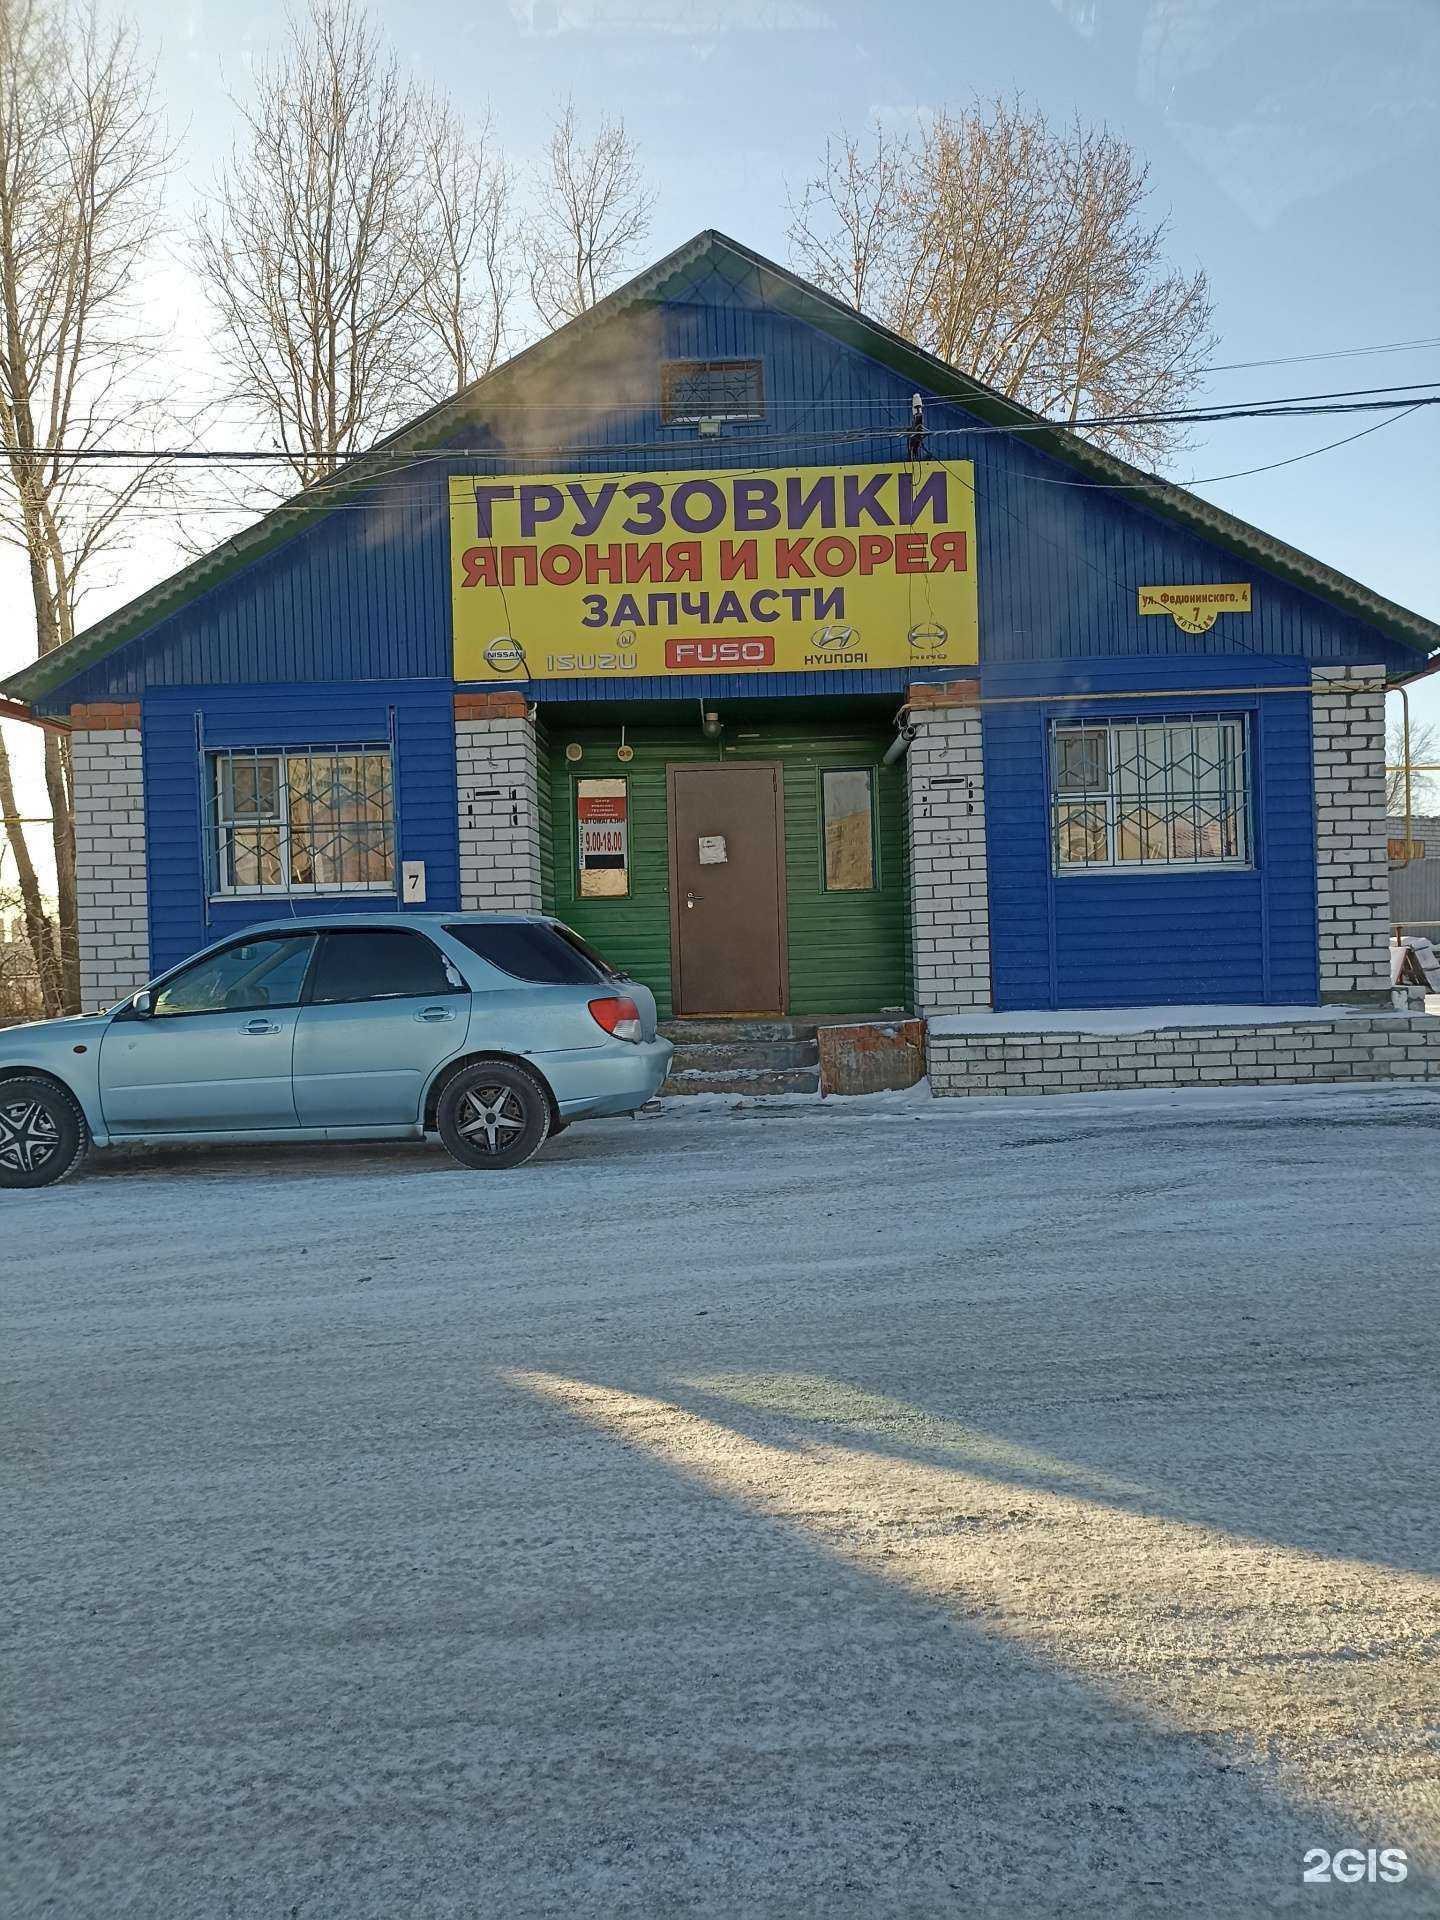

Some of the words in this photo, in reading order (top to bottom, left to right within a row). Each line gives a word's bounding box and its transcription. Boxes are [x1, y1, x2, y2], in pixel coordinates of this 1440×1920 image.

[476, 471, 949, 539] ГРУЗОВИКИ
[461, 539, 703, 588] ЯПОНИЯ
[720, 539, 761, 581] И
[775, 531, 968, 580] КОРЕЯ
[581, 587, 846, 628] ЗАПЧАСТИ
[1192, 606, 1201, 622] 7
[487, 651, 523, 659] NISSAN
[675, 642, 766, 662] FUSO
[804, 653, 868, 665] HYUNDAI
[547, 653, 638, 671] ISUZU
[585, 831, 622, 852] 9.00-18.00
[408, 874, 419, 890] 7
